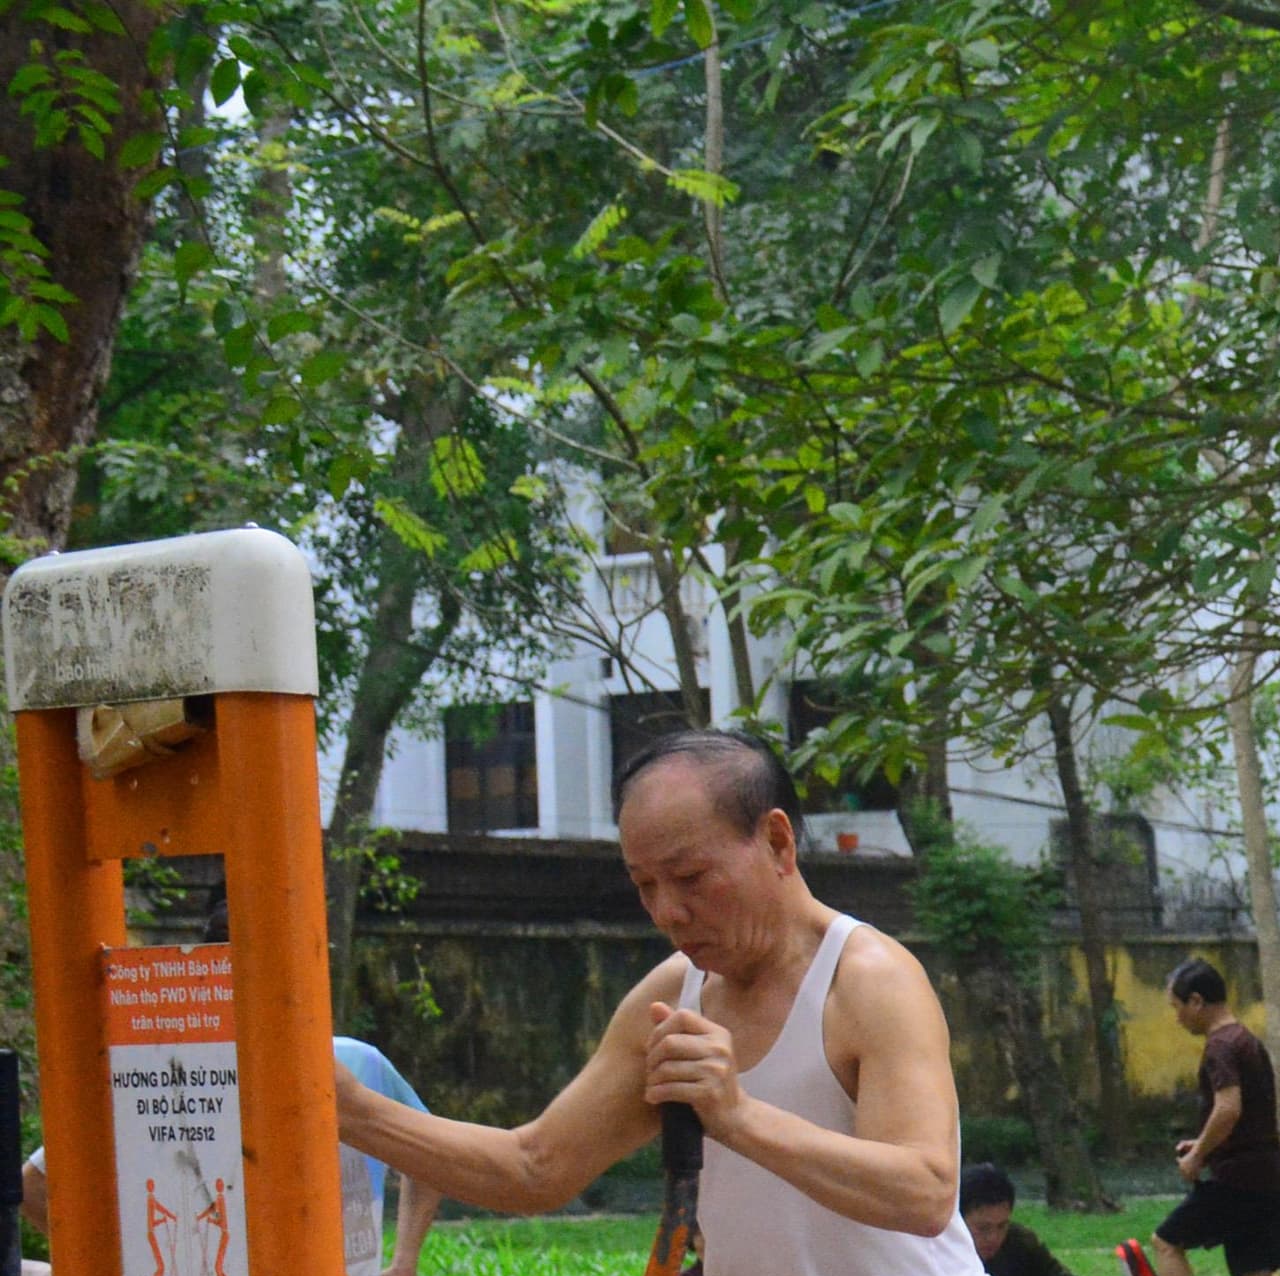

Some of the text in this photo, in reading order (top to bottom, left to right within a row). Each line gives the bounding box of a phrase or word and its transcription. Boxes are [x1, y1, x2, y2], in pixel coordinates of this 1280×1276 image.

[153, 962, 185, 977] TNHH
[160, 988, 186, 1003] FWD
[113, 1068, 157, 1087] HƯỚNG
[211, 1070, 237, 1090] DỤN
[137, 1099, 149, 1115] ĐI
[153, 1095, 169, 1118] BỘ
[200, 1097, 223, 1113] TAY
[149, 1126, 215, 1141] VIFA 712512
